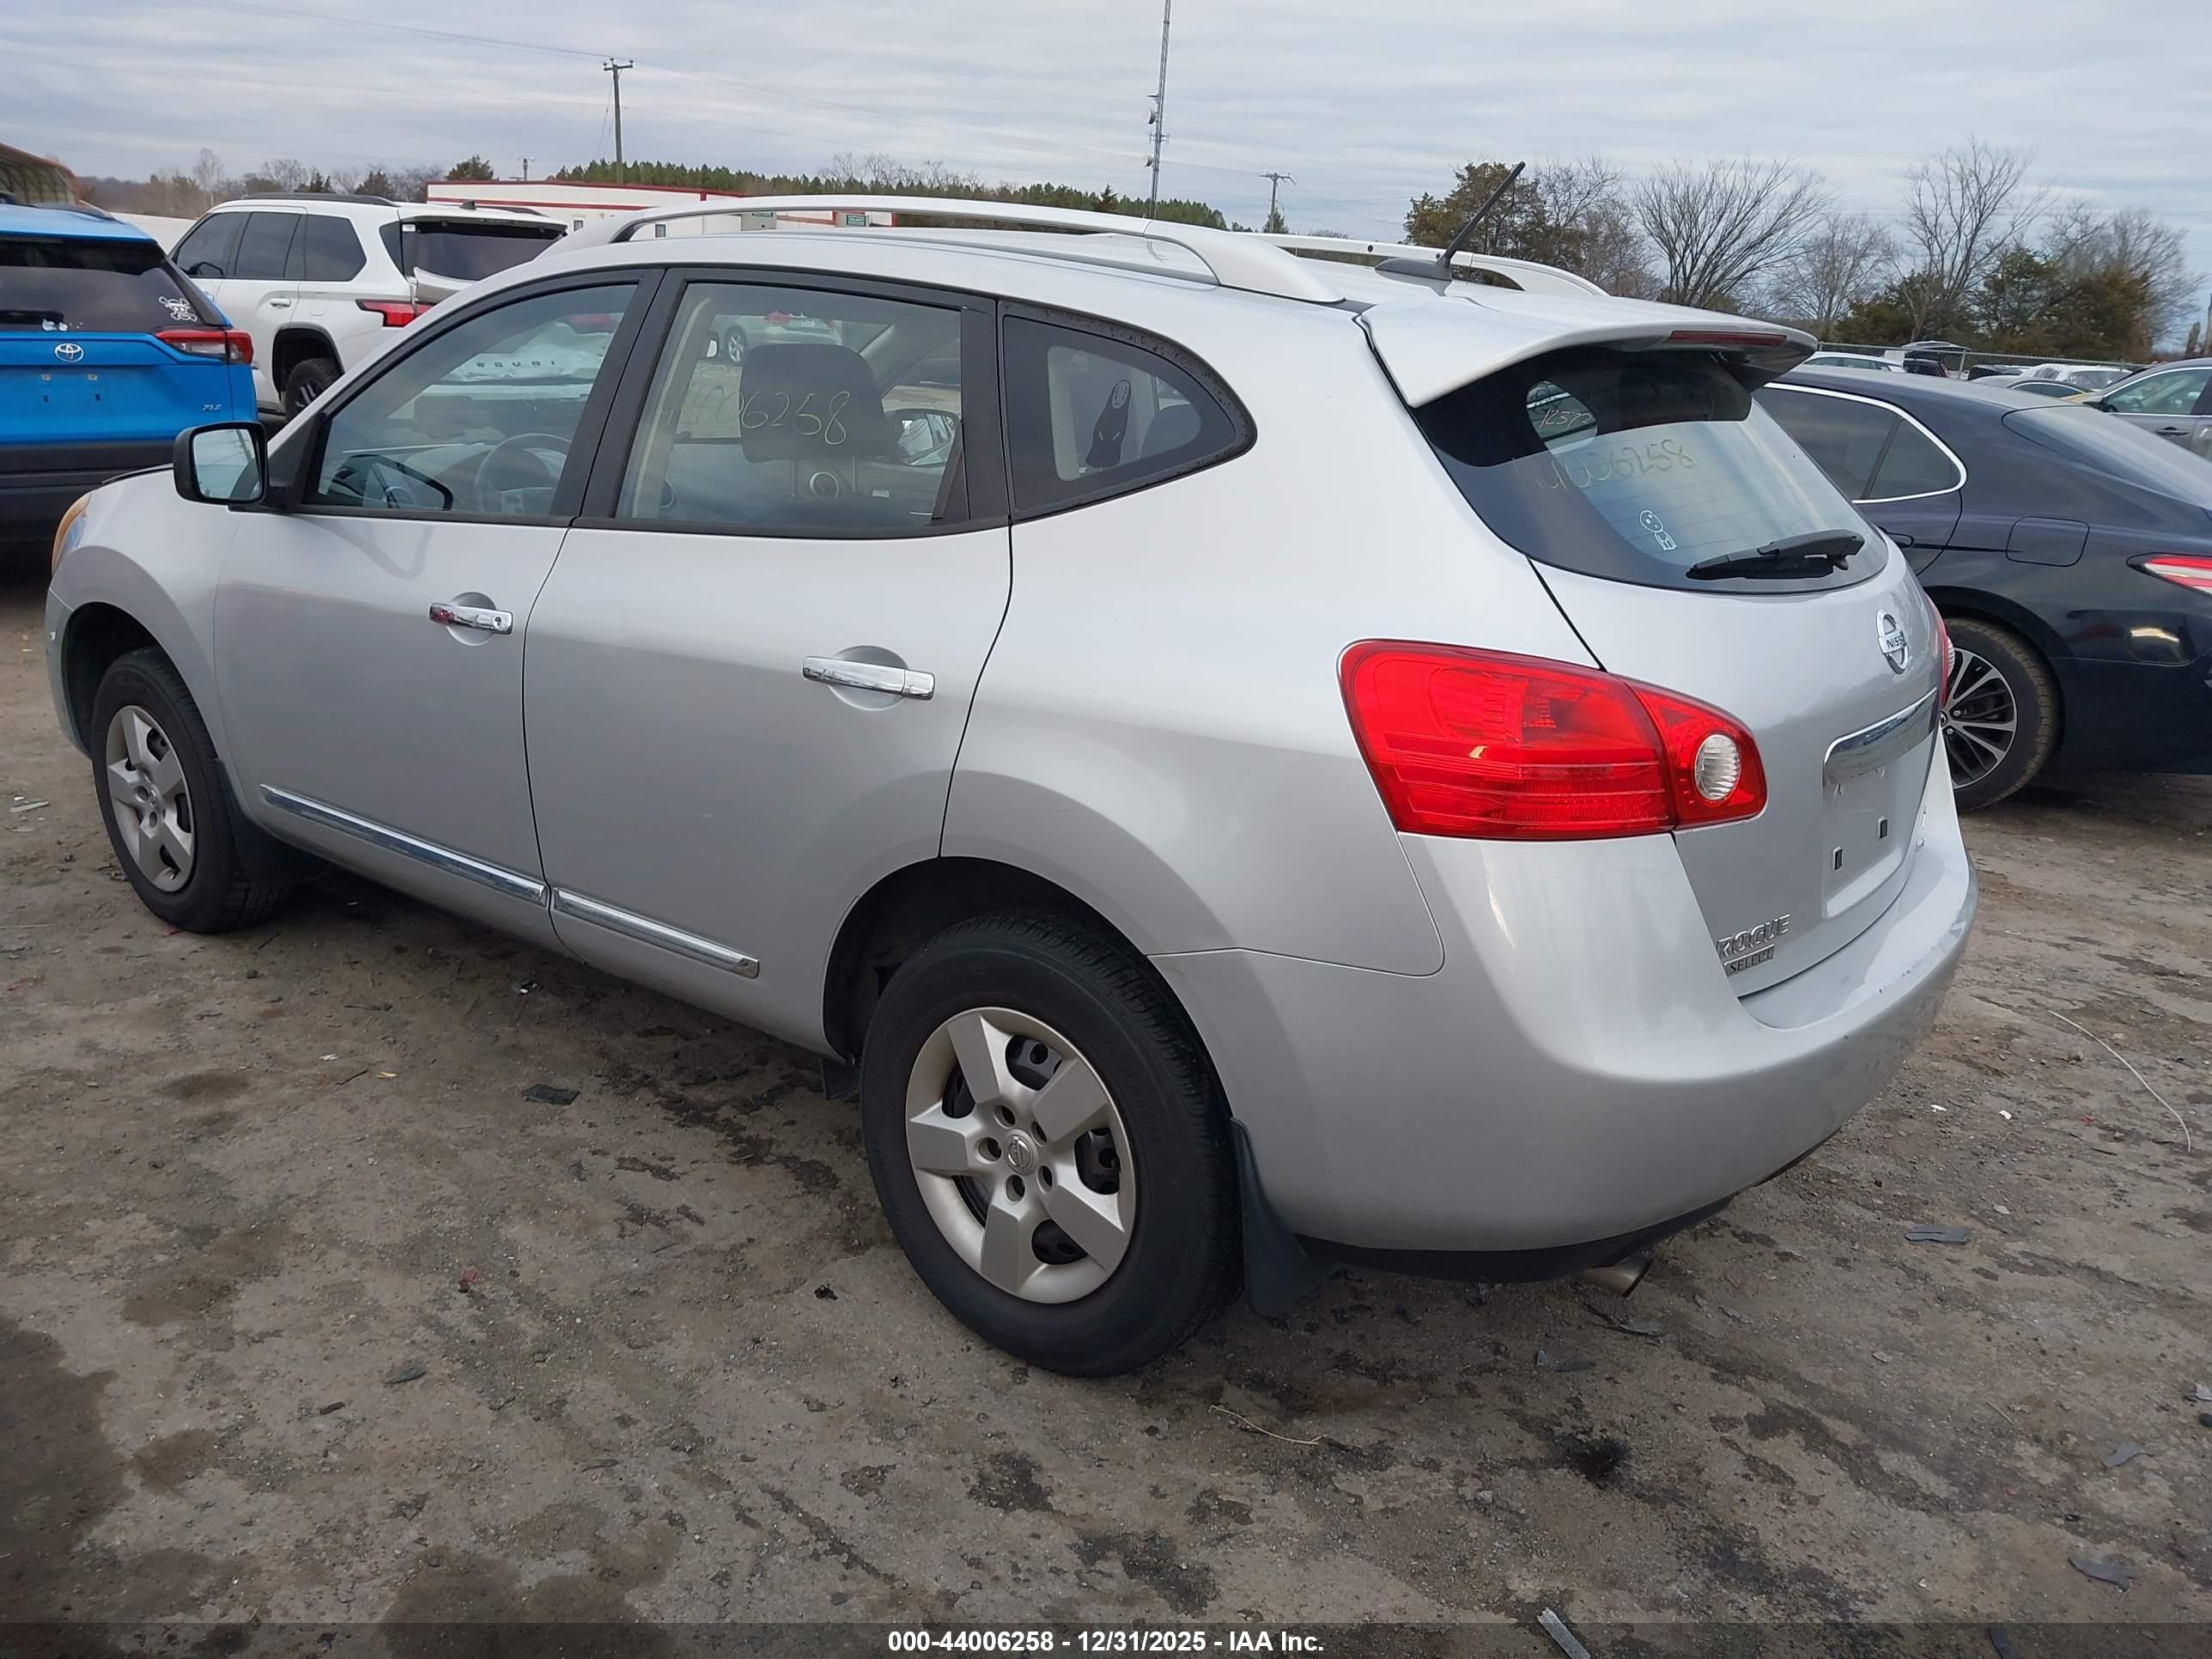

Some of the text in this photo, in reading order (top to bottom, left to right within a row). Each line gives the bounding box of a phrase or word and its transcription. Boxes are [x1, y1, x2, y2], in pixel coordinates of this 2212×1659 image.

[1886, 633, 1905, 649] NISS
[1717, 914, 1790, 957] ROGUE
[1729, 947, 1775, 972] SELECT
